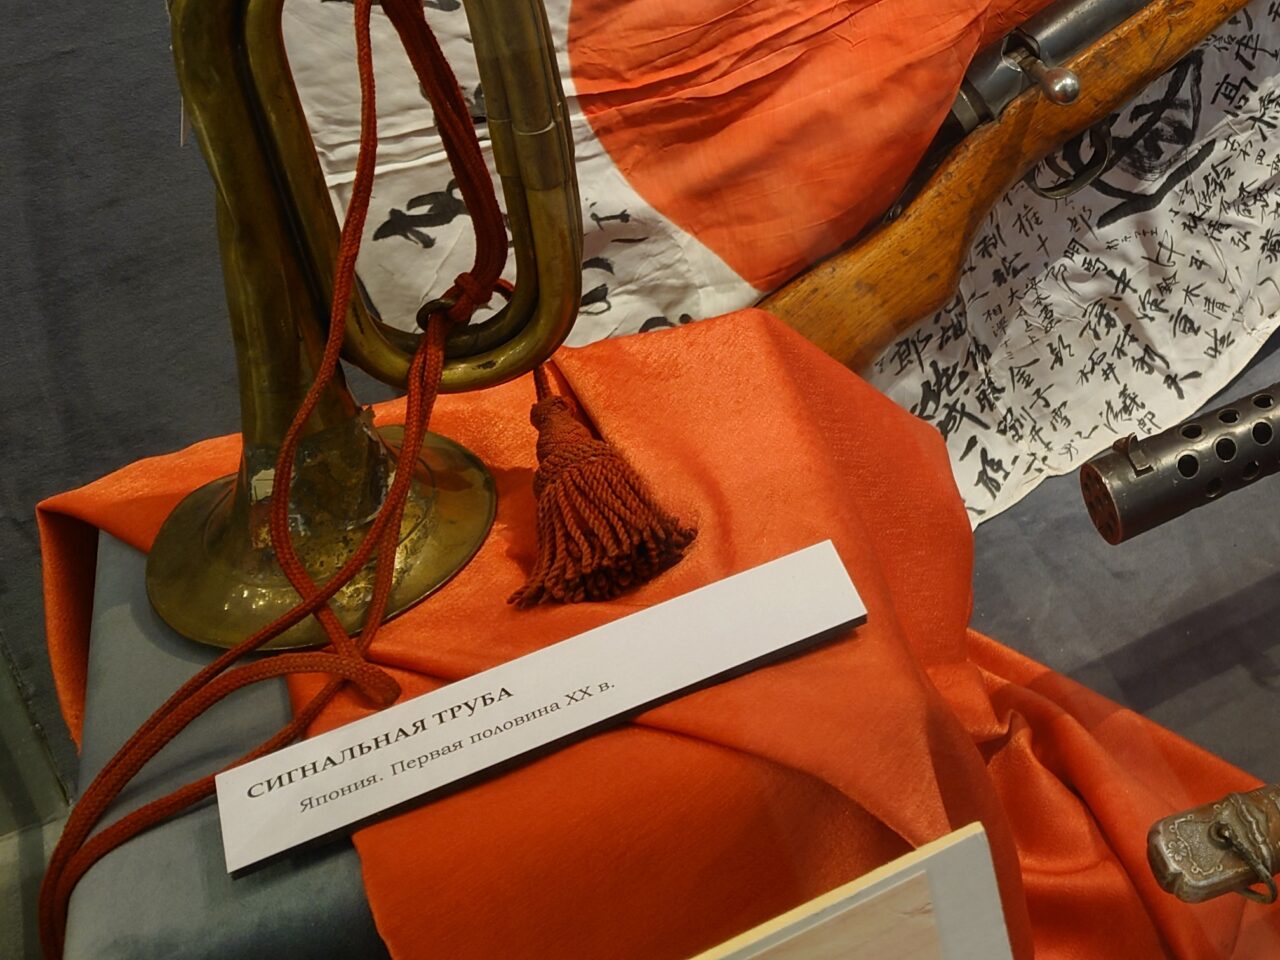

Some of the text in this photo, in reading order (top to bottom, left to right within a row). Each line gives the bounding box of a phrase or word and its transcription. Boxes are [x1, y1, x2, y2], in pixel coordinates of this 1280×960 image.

[246, 686, 515, 800] СИГНАЛЬНАЯ ТРУБА
[298, 680, 616, 814] Япония. Первая половина XX в.
